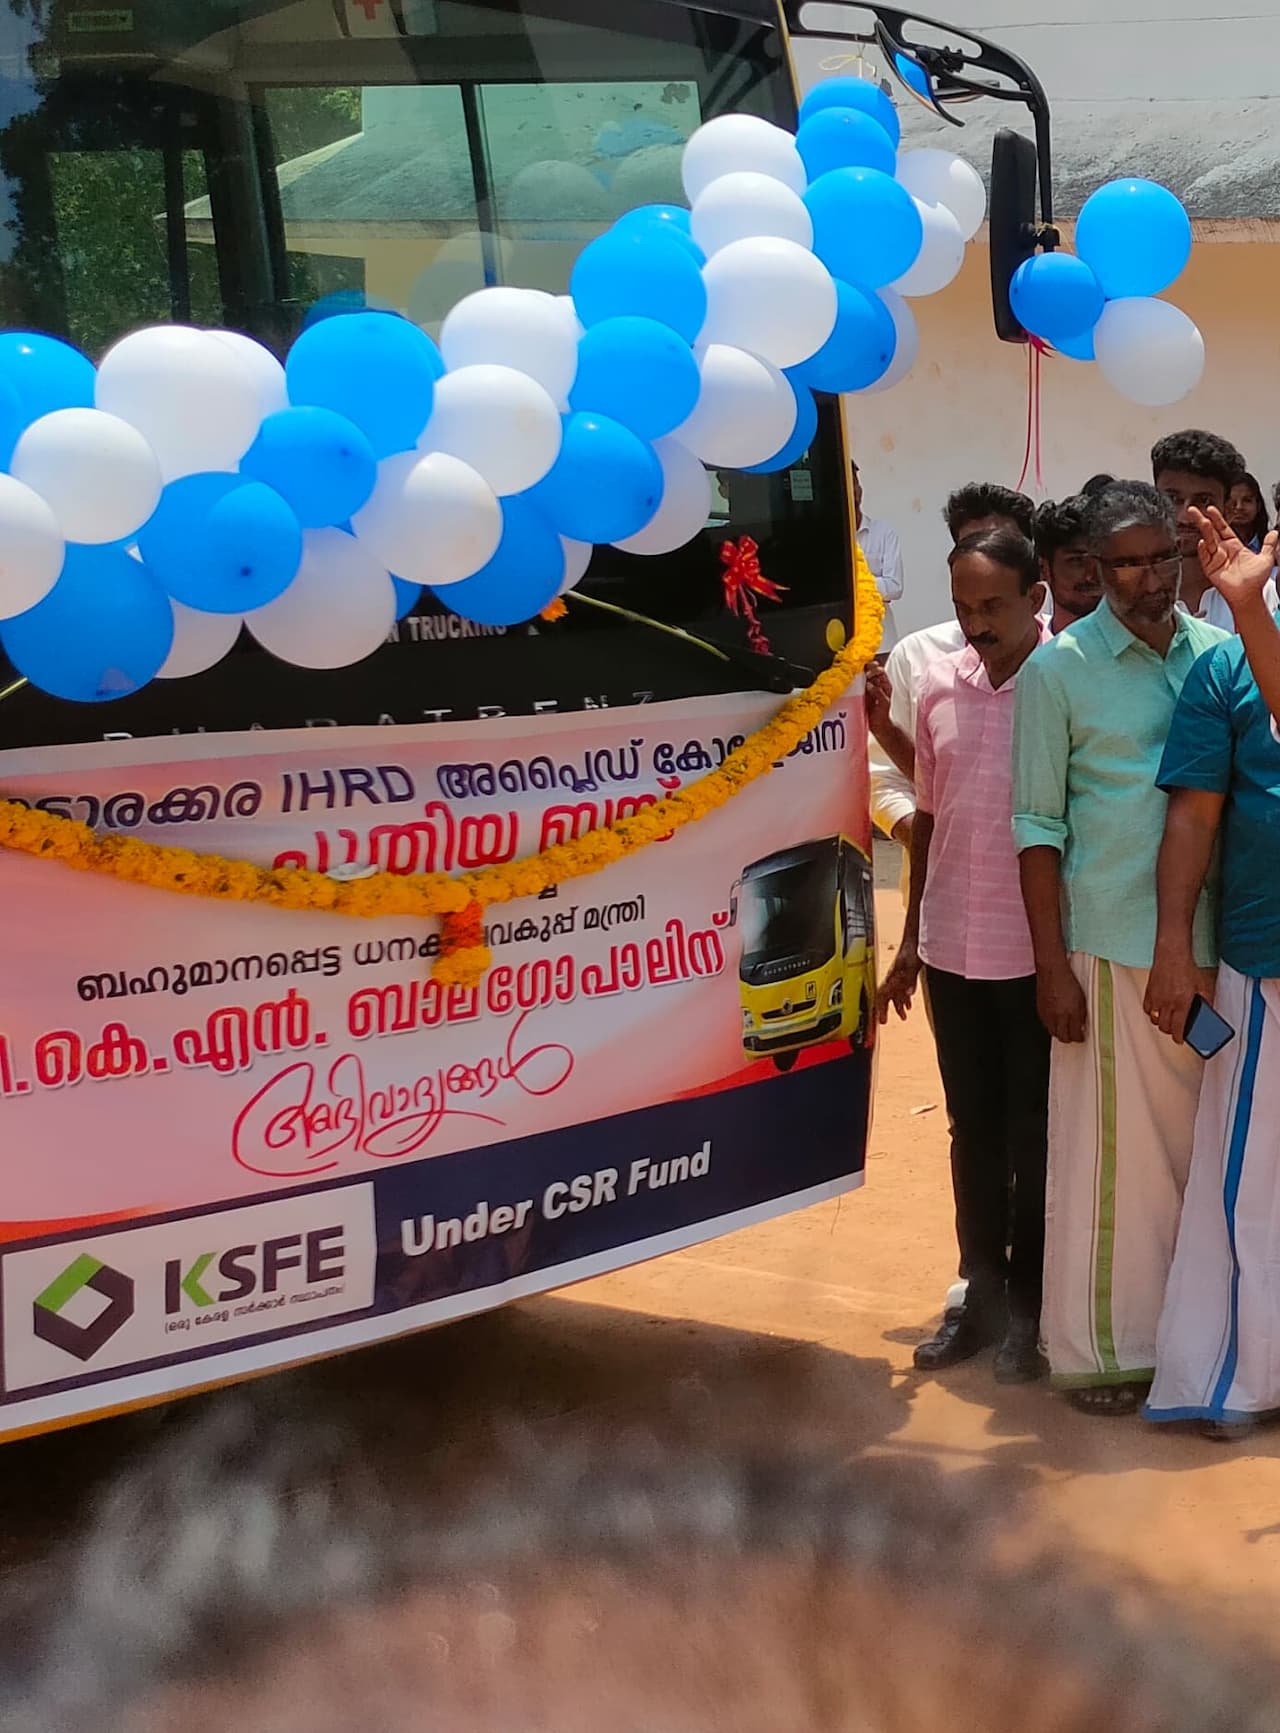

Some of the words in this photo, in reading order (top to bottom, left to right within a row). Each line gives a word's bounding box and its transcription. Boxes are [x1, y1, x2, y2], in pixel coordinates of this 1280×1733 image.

[282, 766, 416, 812] IHRD
[77, 946, 341, 1001] ബഹുമാനപ്പെട്ട
[583, 895, 646, 932] മന്ത്രി
[400, 1200, 533, 1257] Under
[542, 1168, 618, 1220] CSR
[627, 1141, 711, 1195] Fund
[165, 1225, 345, 1315] KSFE
